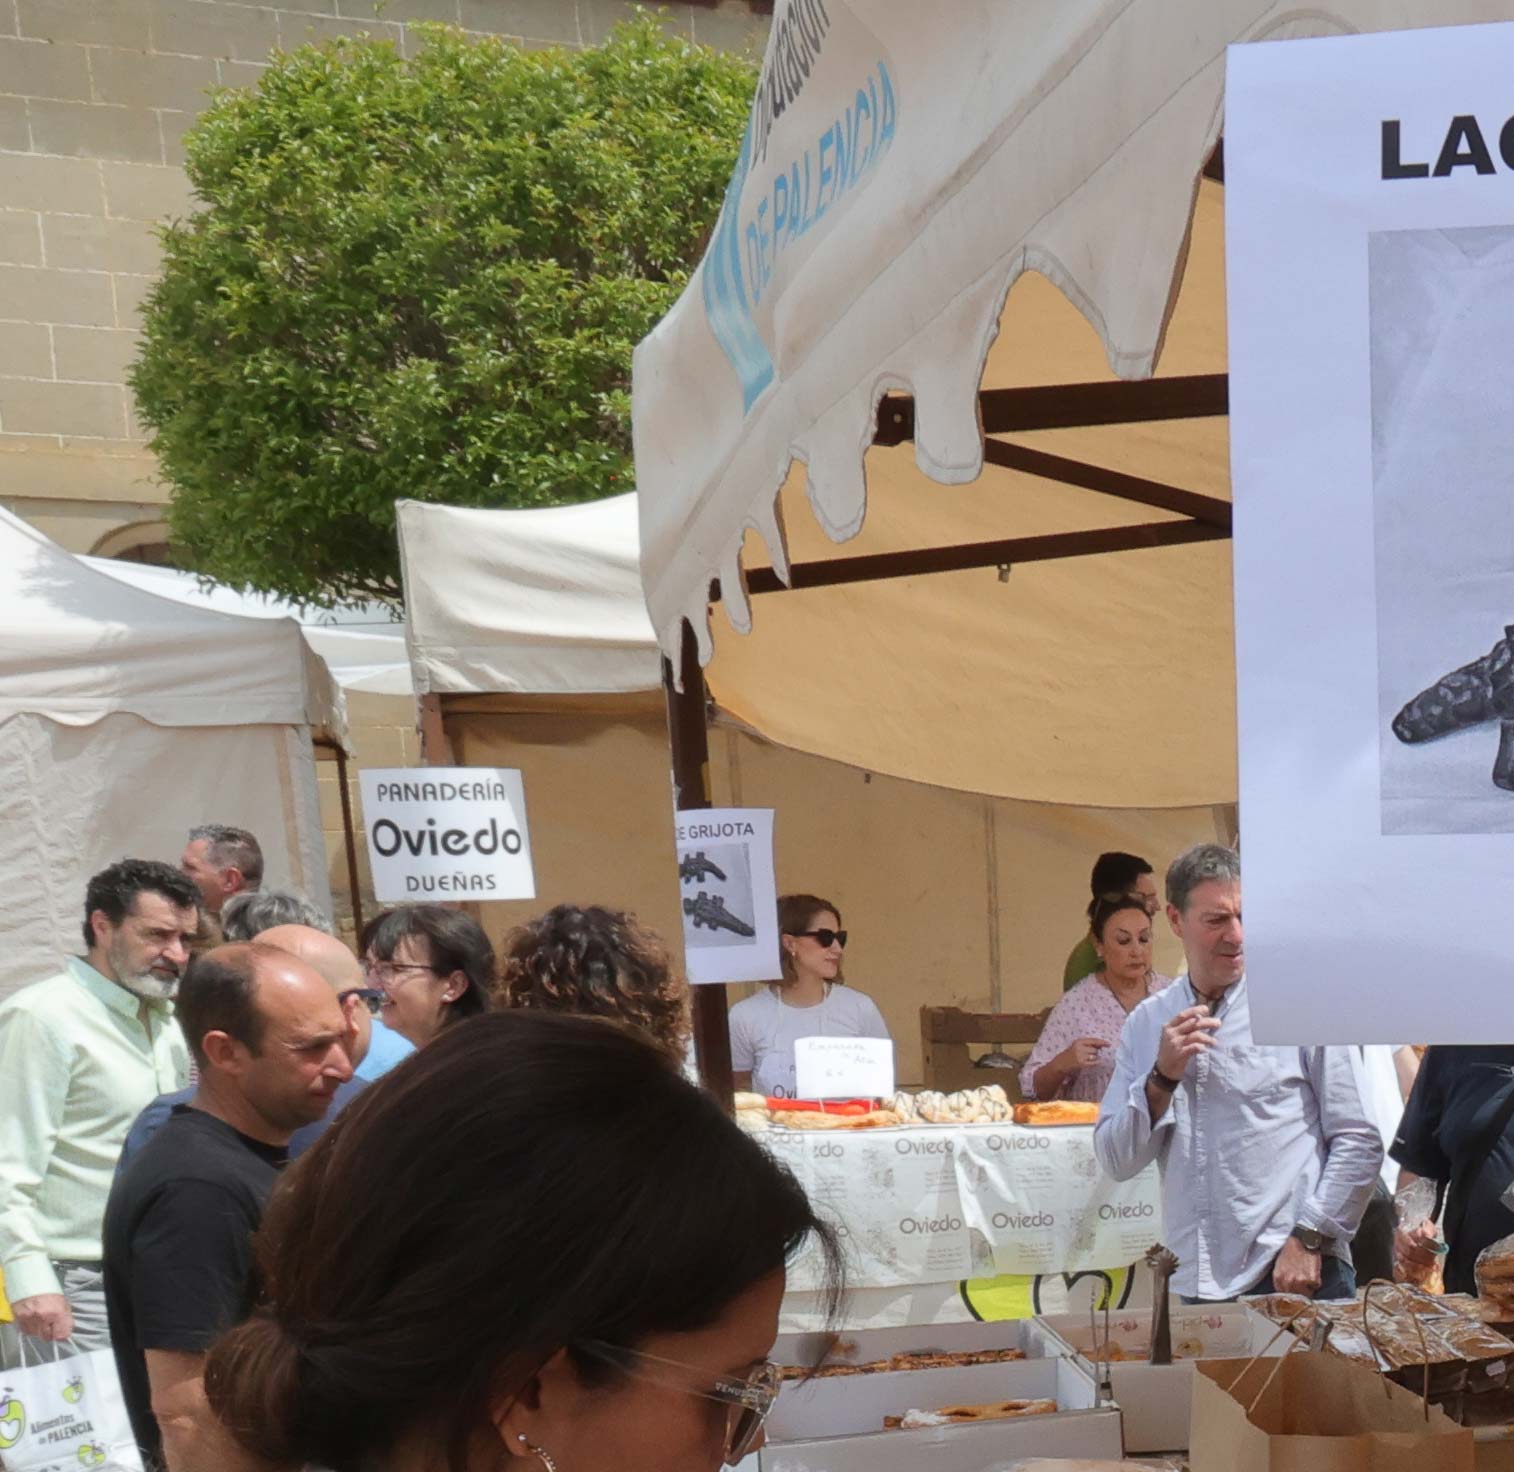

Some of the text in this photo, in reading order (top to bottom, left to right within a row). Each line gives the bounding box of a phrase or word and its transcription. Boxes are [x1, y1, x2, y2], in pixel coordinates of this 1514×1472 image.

[773, 60, 895, 262] PALENCIA
[377, 780, 505, 802] PANADERÍA
[372, 817, 522, 858] Oviedo
[688, 823, 755, 839] GRIJOTA
[406, 871, 497, 892] DUEÑAS
[986, 1133, 1051, 1151] Oviedo
[992, 1211, 1055, 1230] Oviedo
[1099, 1201, 1154, 1221] Oviedo
[899, 1214, 962, 1234] Oviedo
[30, 1413, 75, 1435] Alimentos
[48, 1420, 94, 1443] PALENCIA
